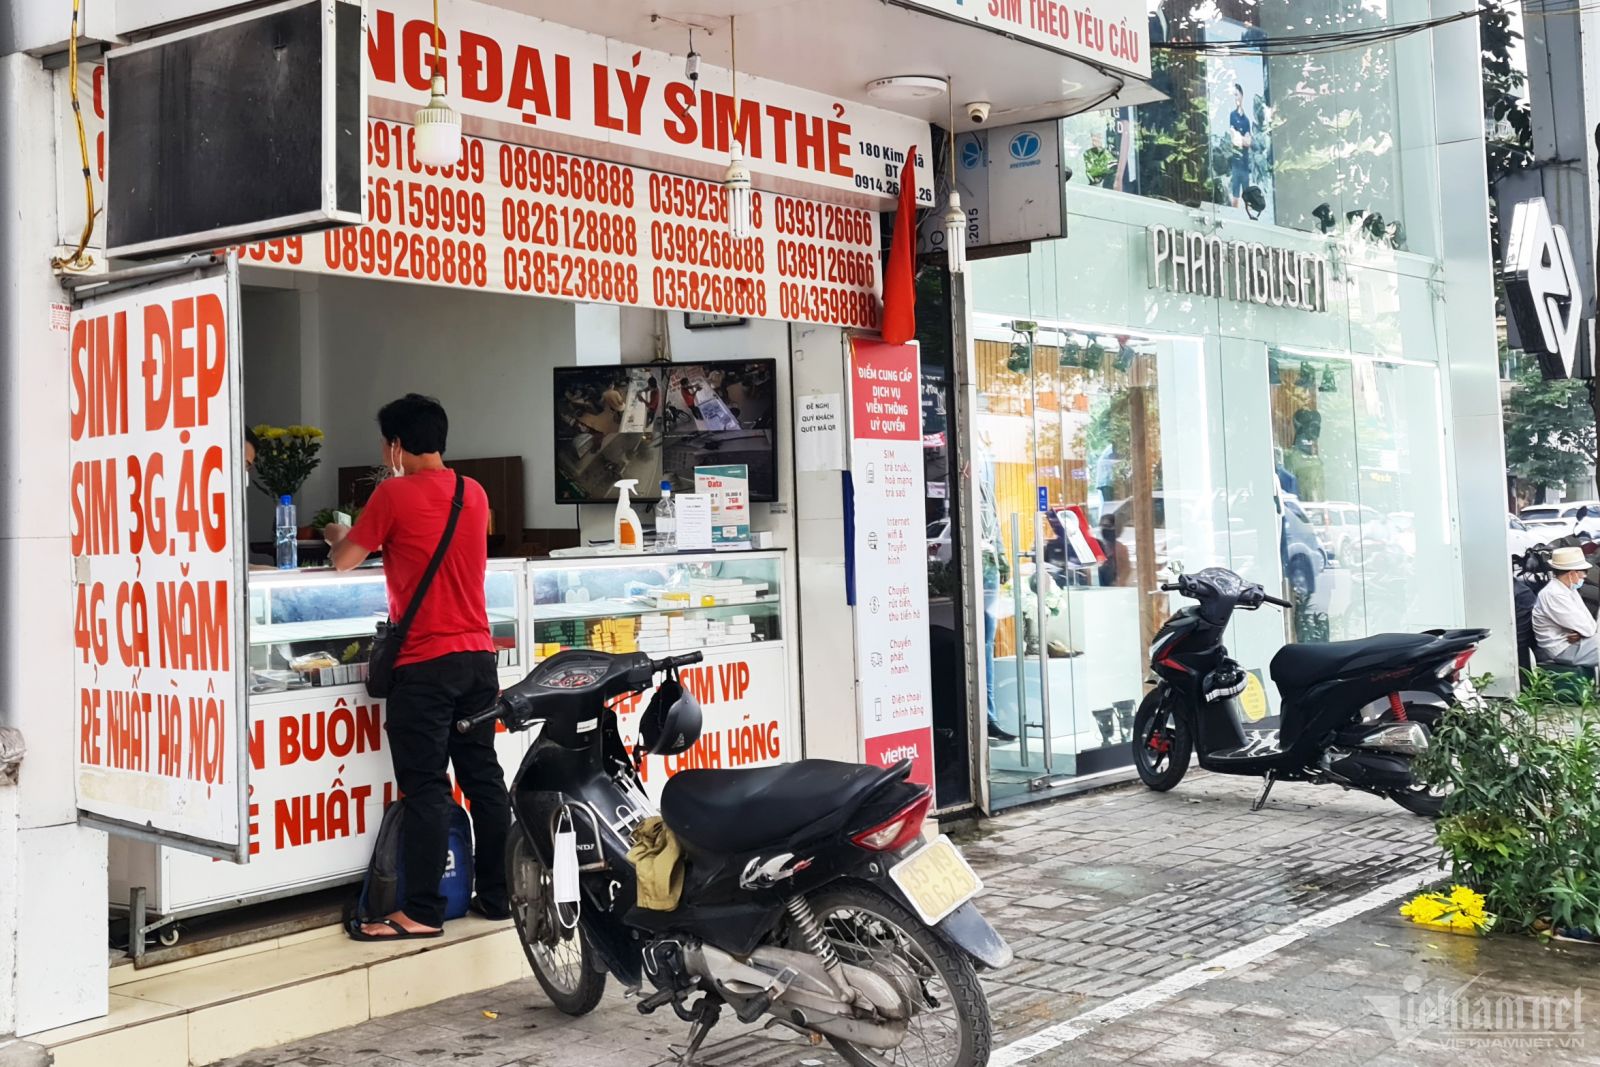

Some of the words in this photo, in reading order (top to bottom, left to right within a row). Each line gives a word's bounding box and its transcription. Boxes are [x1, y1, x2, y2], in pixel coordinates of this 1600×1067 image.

[1029, 0, 1069, 39] THEO
[1074, 7, 1104, 52] YÊU
[458, 30, 571, 125] ĐẠI
[593, 51, 651, 137] LÝ
[663, 82, 763, 159] SIM
[766, 103, 854, 179] THẺ
[499, 144, 635, 208] 0899568888
[859, 141, 880, 158] 180
[883, 146, 904, 163] Kim
[649, 173, 762, 229] 03592588
[855, 174, 932, 202] 0914.26.26
[502, 197, 637, 257] 0826128888
[650, 220, 765, 274] 0398268888
[775, 196, 872, 247] 0393126666
[324, 226, 487, 287] 0899268888
[503, 246, 638, 304] 0385238888
[777, 239, 875, 288] 0389126666
[653, 266, 767, 317] 0358268888
[780, 282, 877, 329] 0843598888
[71, 310, 128, 441] SIM
[141, 293, 226, 444] ĐẸP
[878, 370, 898, 381] CUNG
[71, 457, 120, 557] SIM
[74, 581, 109, 666] 4G
[116, 557, 151, 668] CẢ
[156, 562, 229, 672] NĂM
[719, 661, 750, 702] VIP
[81, 664, 101, 766] RẺ
[107, 668, 152, 773] NHẤT
[158, 679, 182, 778] HÀ
[189, 678, 225, 799] NỘI
[279, 698, 381, 766] BUÔN
[728, 714, 780, 767] HÃNG
[880, 743, 919, 765] viettel
[275, 764, 372, 850] NHẤT
